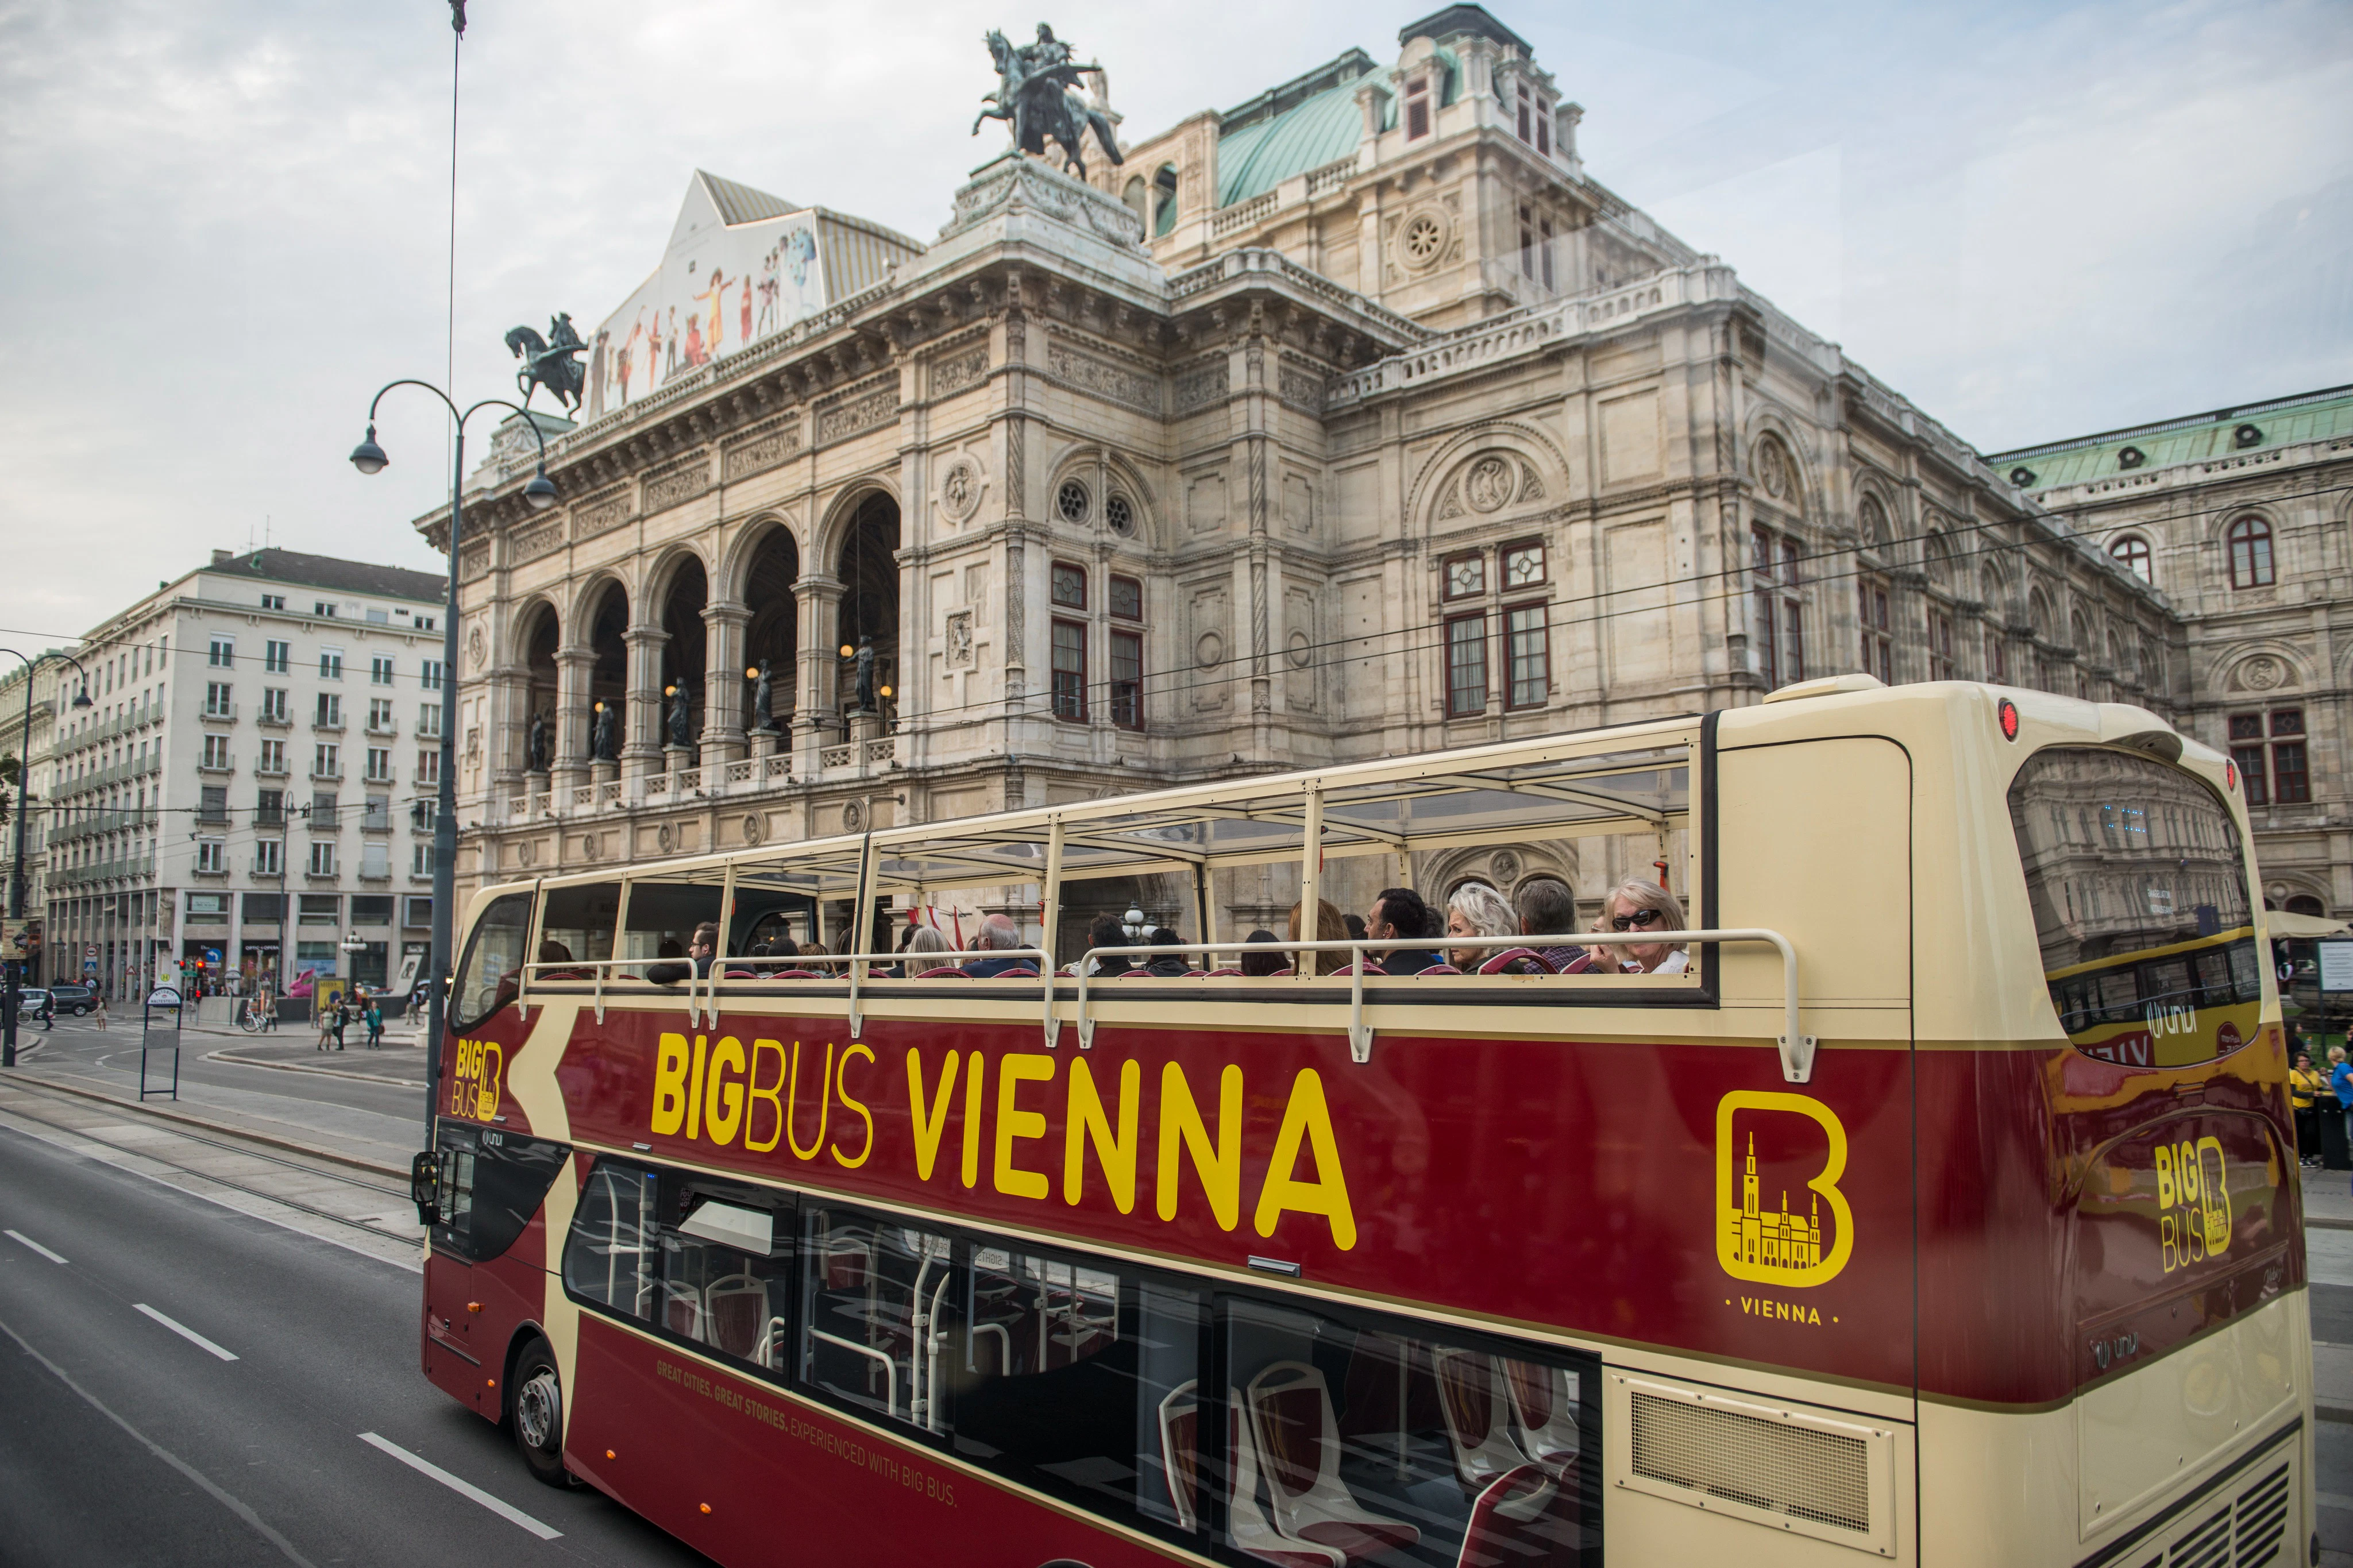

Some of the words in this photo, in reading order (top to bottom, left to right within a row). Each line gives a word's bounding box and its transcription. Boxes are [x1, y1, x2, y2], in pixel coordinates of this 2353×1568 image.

[456, 1039, 483, 1080] BIG
[452, 1080, 478, 1118] BUS
[907, 1047, 1357, 1251] VIENNA
[2154, 1140, 2198, 1210] BIG
[2162, 1206, 2205, 1273] BUS
[1741, 1296, 1822, 1326] VIENNA
[657, 1360, 682, 1384] GREAT
[684, 1372, 713, 1399] CITIES.
[715, 1385, 743, 1412] GREAT
[745, 1398, 788, 1432] STORIES.
[790, 1417, 865, 1466] EXPERIENCED
[868, 1451, 898, 1482] WITH
[902, 1465, 923, 1492] BIG
[927, 1476, 958, 1509] BUS.
